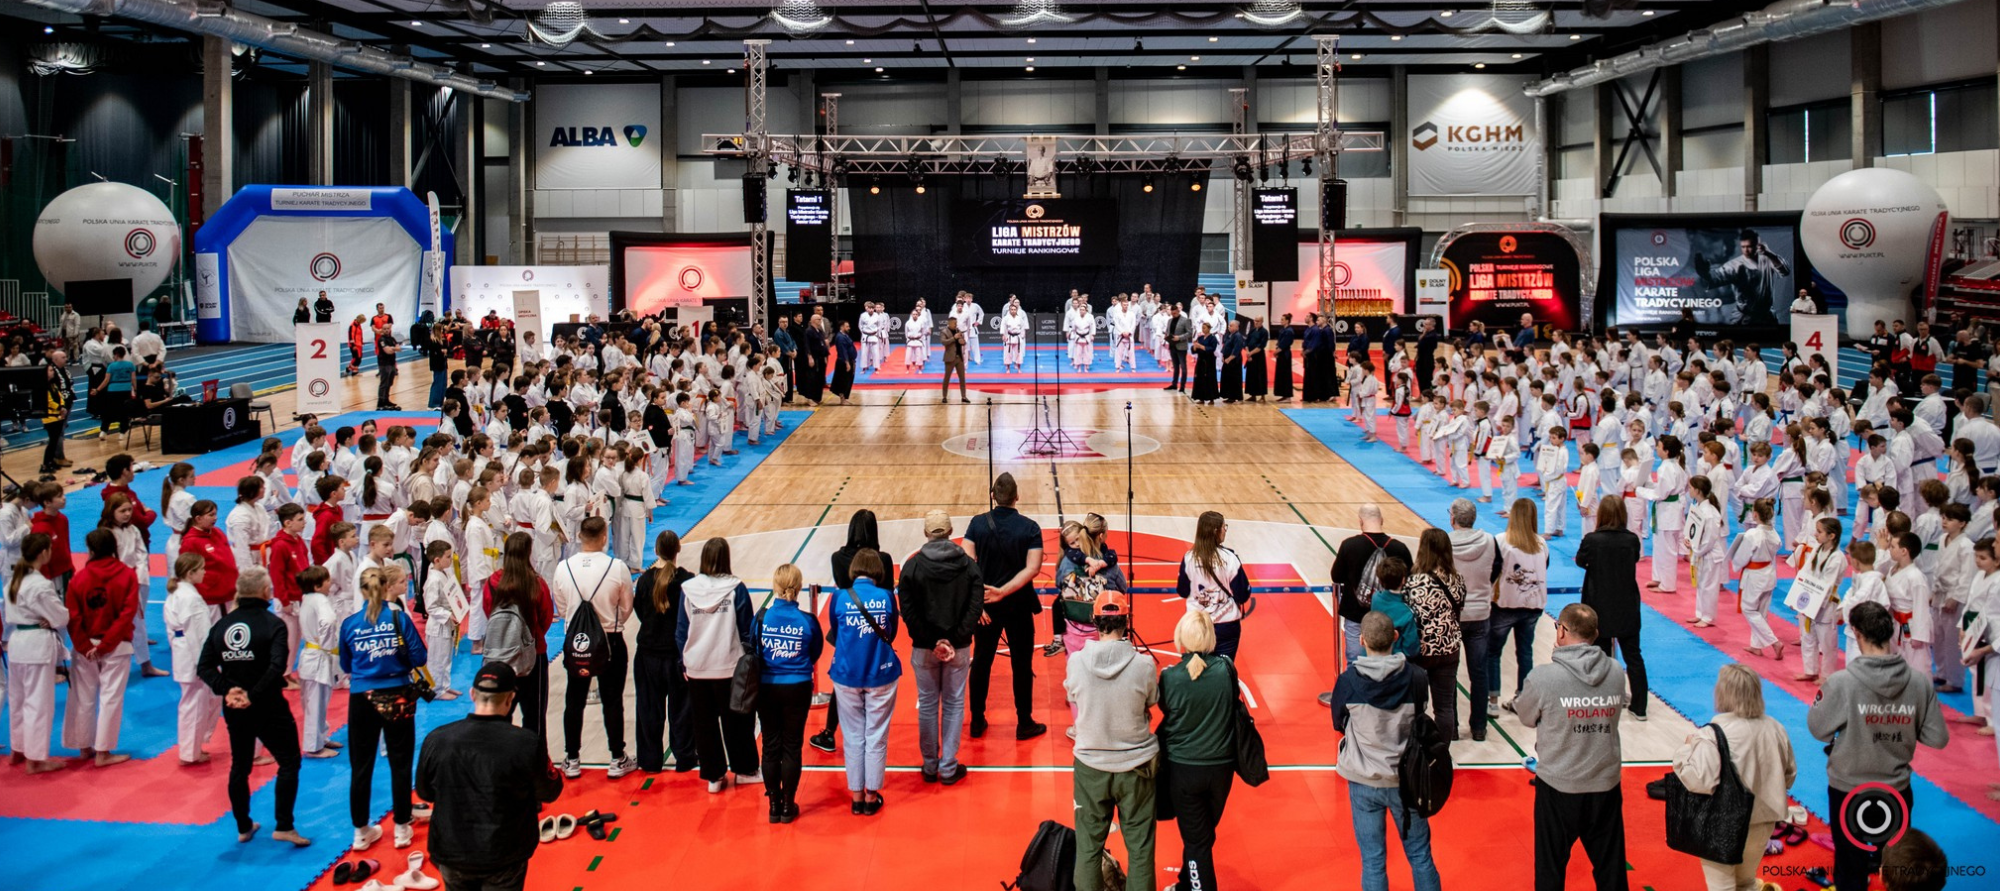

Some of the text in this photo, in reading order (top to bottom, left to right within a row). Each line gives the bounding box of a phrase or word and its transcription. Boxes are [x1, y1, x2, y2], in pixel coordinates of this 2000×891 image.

[549, 126, 618, 147] ALBA
[1447, 125, 1523, 143] KGHM
[292, 191, 320, 199] PUCHAR
[818, 195, 823, 203] 1
[1284, 194, 1288, 202] 1
[1870, 205, 1921, 214] TRADYCYJNEGO
[992, 224, 1081, 237] LIGA MISTRZÓW
[1634, 257, 1679, 266] POLSKA
[1469, 263, 1495, 273] POLSKA
[1634, 267, 1660, 276] LIGA
[1469, 270, 1553, 289] LIGA MISTRZÓW
[1498, 289, 1553, 300] TRADYCYJNEGO
[1635, 287, 1678, 297] KARATE
[1635, 298, 1722, 308] TRADYCYJNEGO
[692, 320, 699, 338] 1
[1805, 331, 1823, 351] 4
[310, 339, 327, 359] 2
[863, 599, 886, 609] ŁÓDŹ
[846, 614, 886, 626] KARTE
[375, 621, 395, 633] ŁÓD
[780, 624, 804, 635] ŁÓDŹ
[354, 637, 399, 652] KARATE
[761, 637, 802, 650] KARATE
[222, 650, 255, 661] POLSKA
[770, 646, 800, 660] Team
[1560, 695, 1621, 708] WROCŁAW
[1567, 707, 1616, 719] POLAND
[1858, 703, 1916, 714] WROCŁAW
[1866, 714, 1912, 725] POLAND
[1188, 860, 1203, 891] das
